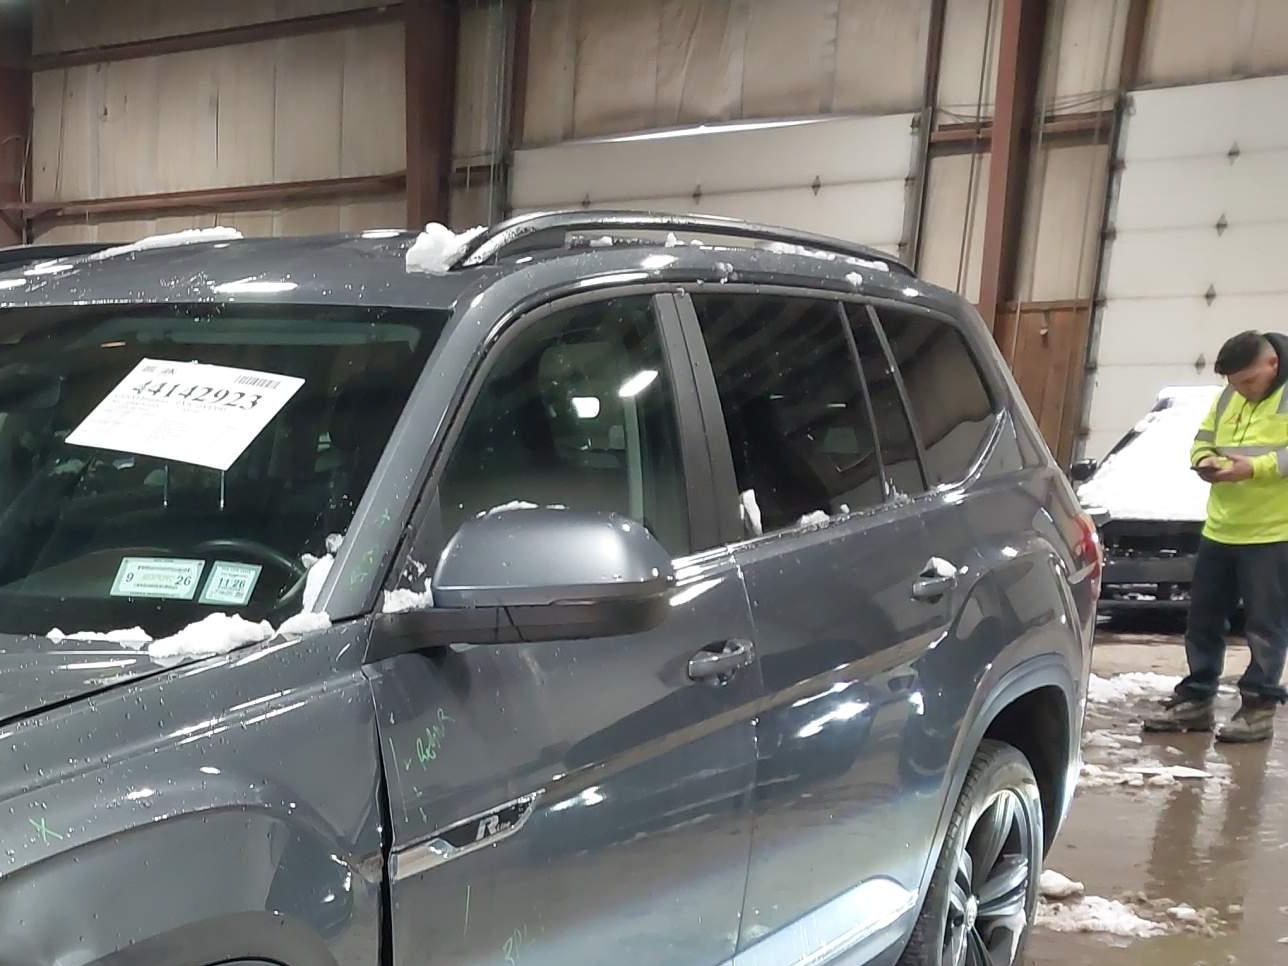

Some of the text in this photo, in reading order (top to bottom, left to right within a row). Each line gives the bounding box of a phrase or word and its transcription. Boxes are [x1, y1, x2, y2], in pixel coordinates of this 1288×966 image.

[132, 379, 263, 410] 44142923
[125, 572, 135, 584] 9
[174, 575, 192, 587] 26
